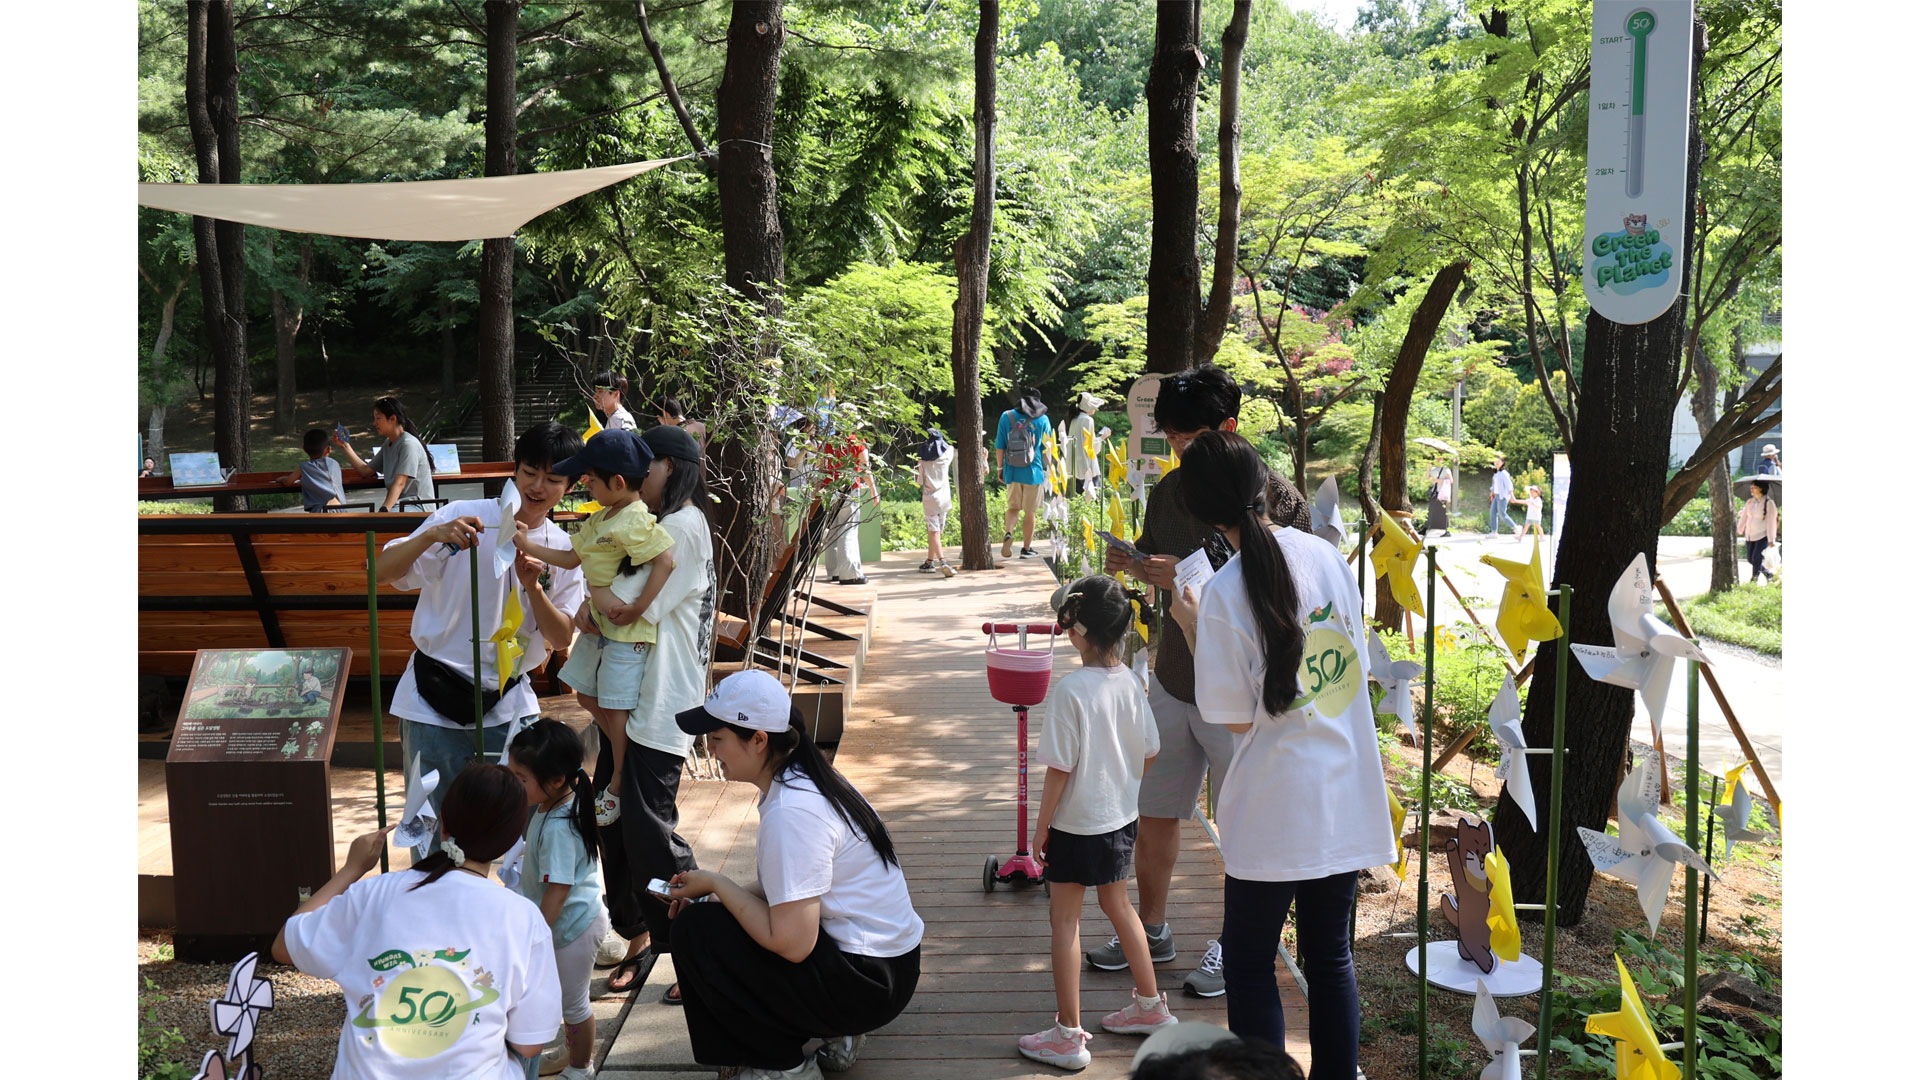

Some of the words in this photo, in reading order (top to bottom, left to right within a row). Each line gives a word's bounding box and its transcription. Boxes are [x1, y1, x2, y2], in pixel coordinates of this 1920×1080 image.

[1632, 18, 1650, 30] 50
[1600, 36, 1623, 45] START
[1598, 102, 1615, 110] 1일차
[1595, 167, 1614, 176] 2일차
[1592, 229, 1660, 257] Green
[1615, 246, 1652, 267] The
[1597, 251, 1673, 288] Planet
[373, 952, 402, 967] HYUNDAI
[383, 960, 398, 969] WIA
[390, 1026, 450, 1038] ANNIVERSARY
